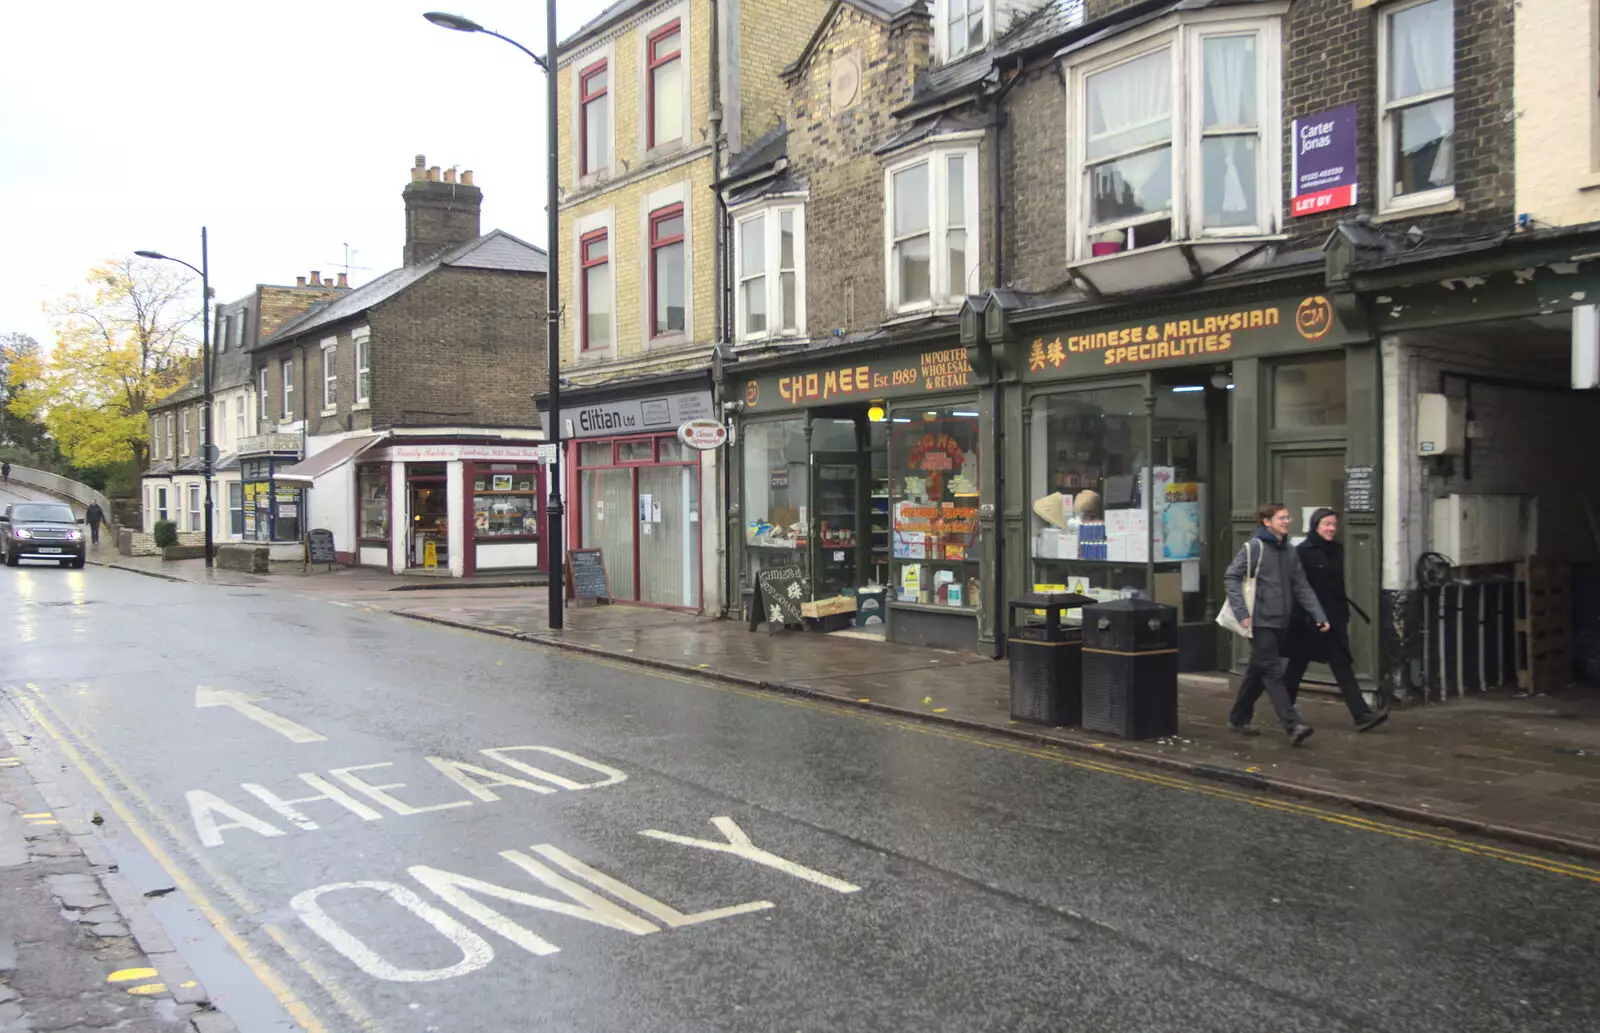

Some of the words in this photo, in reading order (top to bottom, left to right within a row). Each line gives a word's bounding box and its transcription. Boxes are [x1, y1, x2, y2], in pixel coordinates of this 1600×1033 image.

[1300, 121, 1335, 139] Carter
[1300, 135, 1332, 155] Jonas
[1295, 198, 1316, 212] LET
[1317, 194, 1332, 207] BY
[1067, 326, 1143, 352] CHINESE
[1145, 323, 1160, 342] &
[1162, 307, 1279, 342] MALAYSIAN
[920, 347, 968, 366] IMPORTER
[1103, 333, 1233, 366] SPECIALITIES
[778, 372, 819, 405] CHO
[823, 366, 870, 400] MEE
[891, 368, 918, 385] 1989
[925, 377, 934, 390] &
[934, 371, 969, 389] RETAIL
[579, 408, 622, 432] Elitian
[622, 414, 636, 428] Ltd
[185, 745, 629, 848] AHEAD
[290, 815, 863, 983] ONLY
